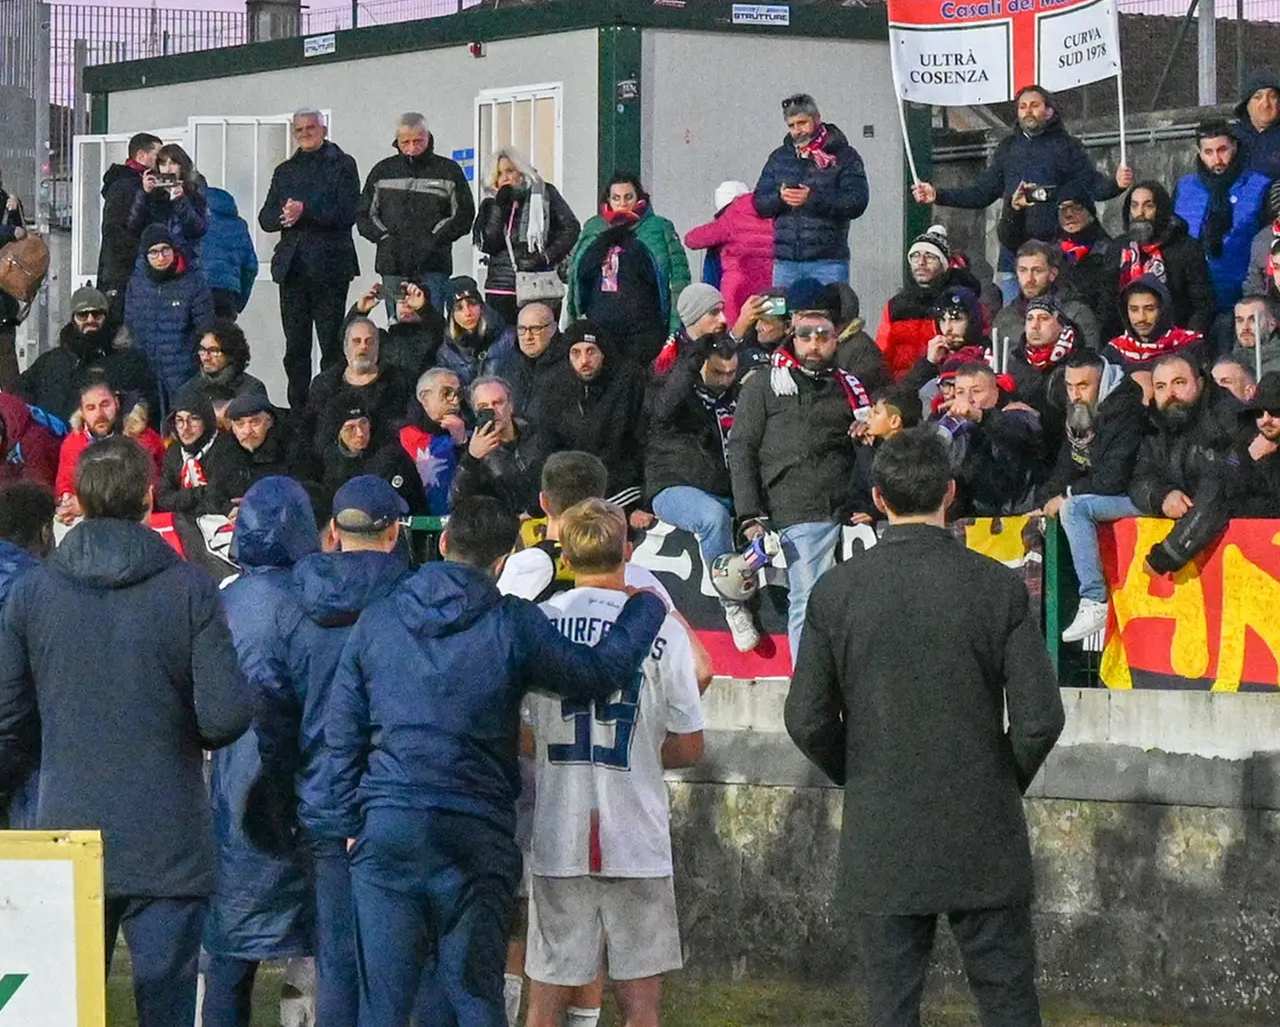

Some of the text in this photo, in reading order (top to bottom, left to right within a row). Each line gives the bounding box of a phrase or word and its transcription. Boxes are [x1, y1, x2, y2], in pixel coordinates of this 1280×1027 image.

[1063, 26, 1102, 50] CURVA
[919, 48, 977, 67] ULTRÀ
[1058, 43, 1107, 69] SUD 1978
[910, 68, 989, 85] COSENZA
